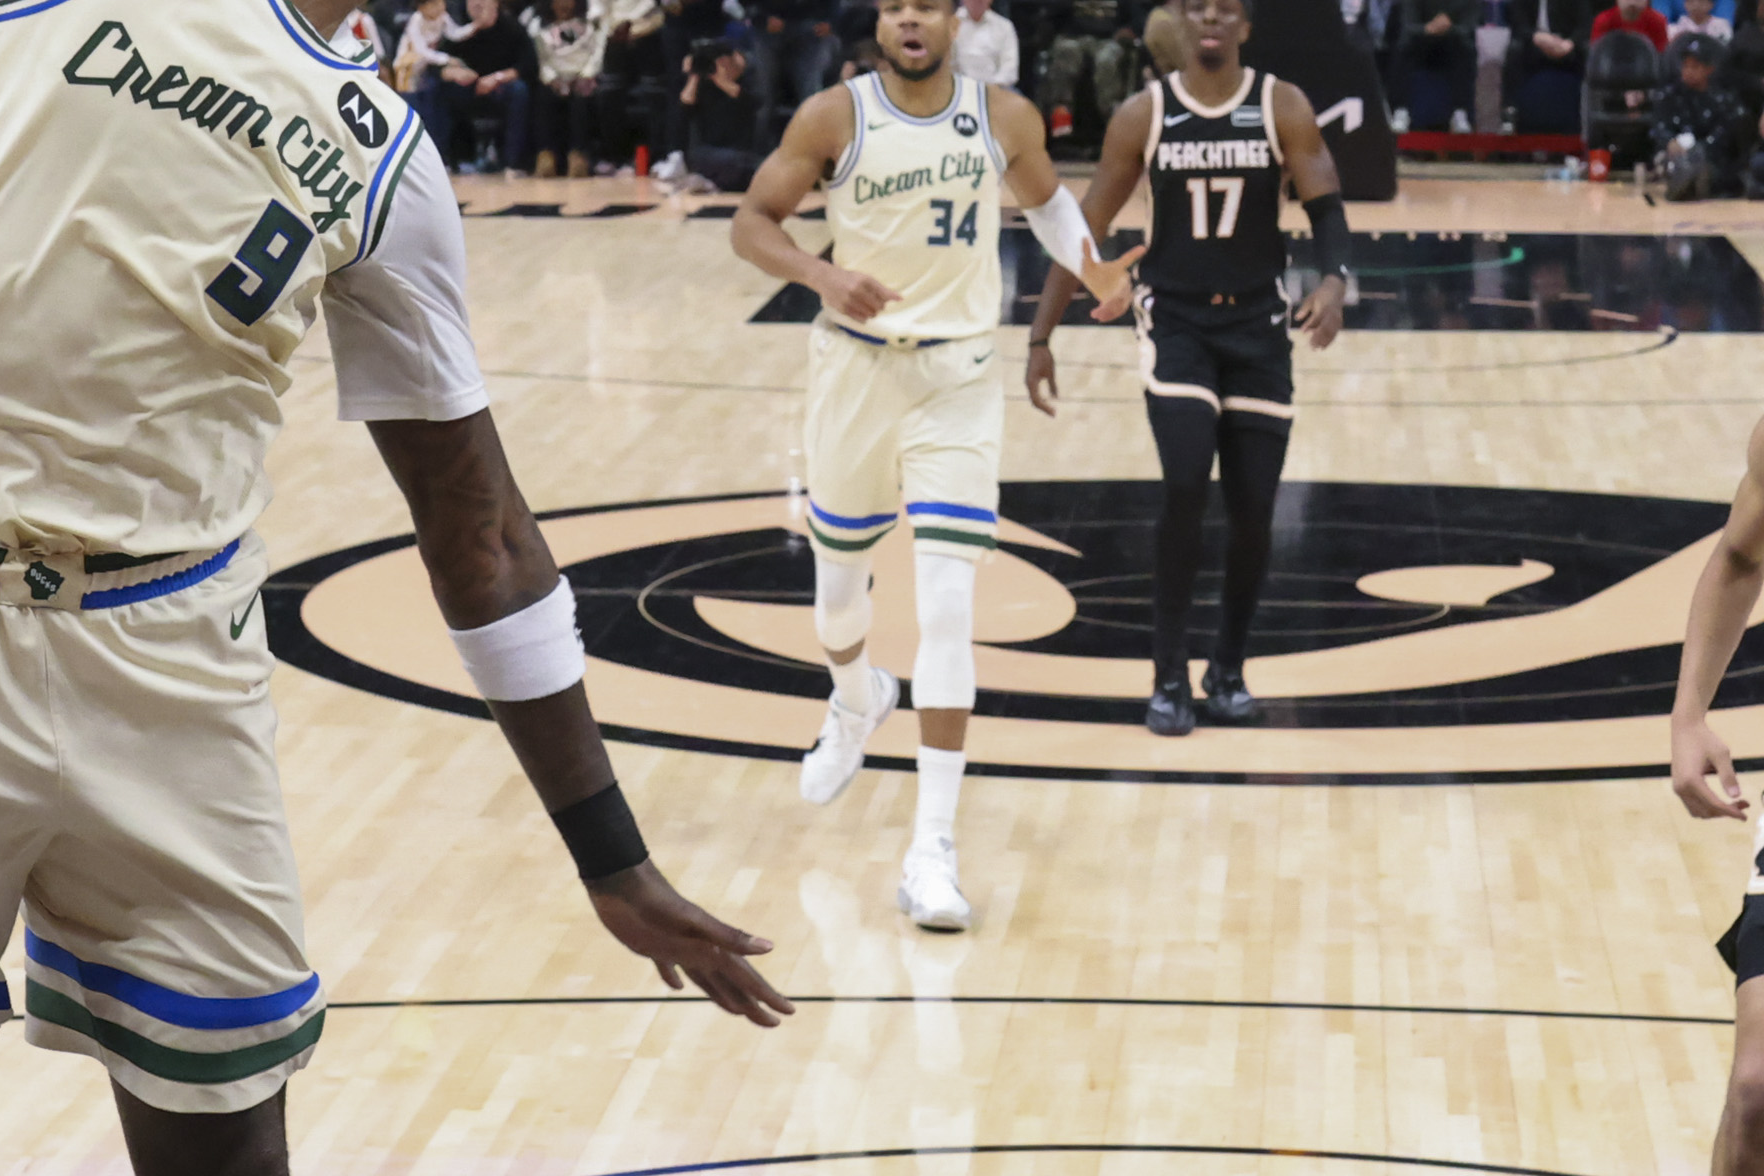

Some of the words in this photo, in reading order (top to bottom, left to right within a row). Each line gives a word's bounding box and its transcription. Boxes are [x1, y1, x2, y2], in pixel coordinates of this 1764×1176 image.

[62, 20, 273, 149] Cream
[276, 115, 364, 235] City
[1157, 139, 1270, 171] PEACHTREE
[854, 167, 934, 205] Cream
[939, 149, 988, 190] City
[927, 198, 979, 247] 34
[1186, 176, 1245, 240] 17
[204, 198, 315, 327] 9
